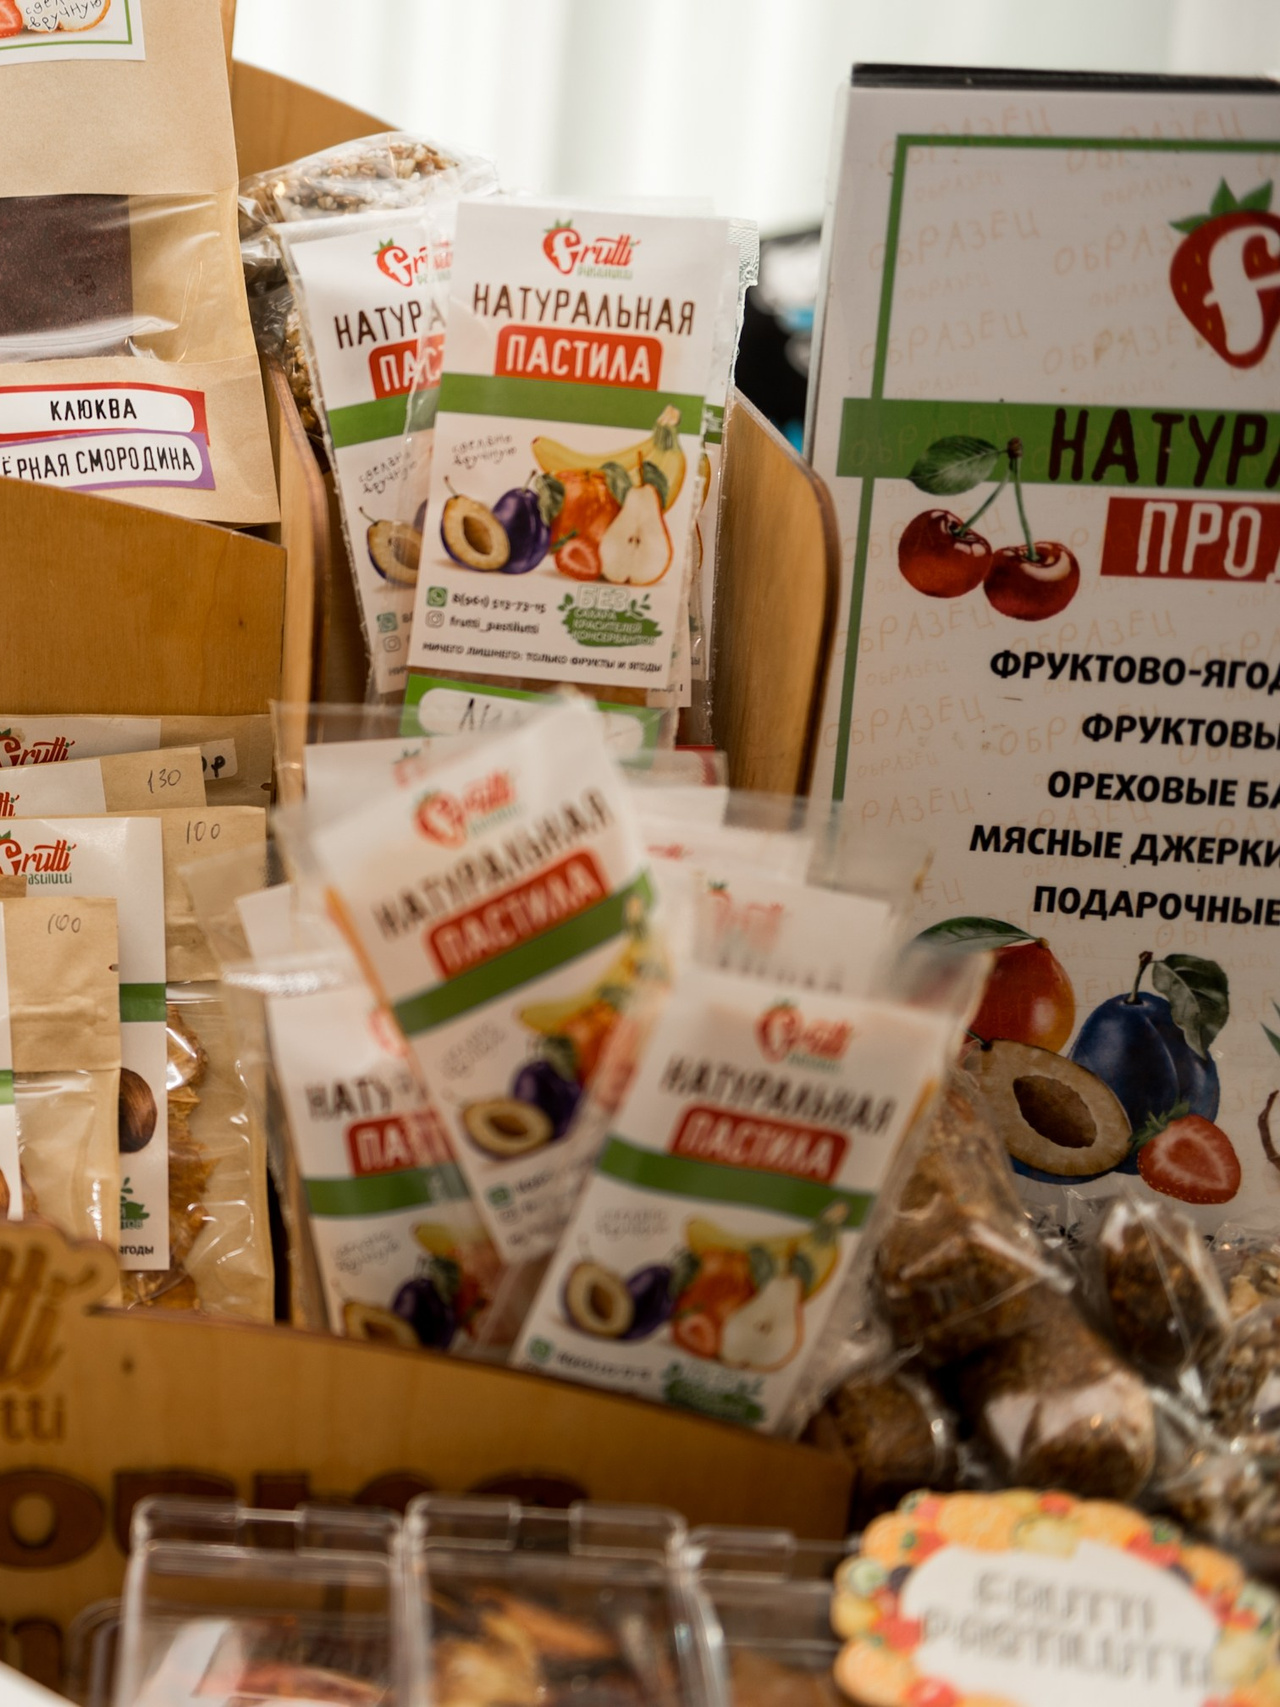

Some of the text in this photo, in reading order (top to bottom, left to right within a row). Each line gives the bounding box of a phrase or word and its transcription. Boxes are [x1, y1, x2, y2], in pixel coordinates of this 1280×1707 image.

[473, 282, 696, 335] НАТУРАЛЬНАЯ
[379, 344, 444, 392] ПАС
[505, 333, 651, 384] ПАСТИЛА
[50, 398, 137, 421] КЛЮКВА
[76, 446, 195, 475] СМОРОДИНА
[1136, 500, 1280, 583] ПРО
[147, 769, 181, 793] 130
[1048, 771, 1238, 807] ОРЕХОВЫЕ
[185, 820, 221, 844] 100
[969, 824, 1123, 859] МЯСНЫЕ
[21, 872, 72, 885] astilutti
[679, 1110, 835, 1178] ПАСТИЛА
